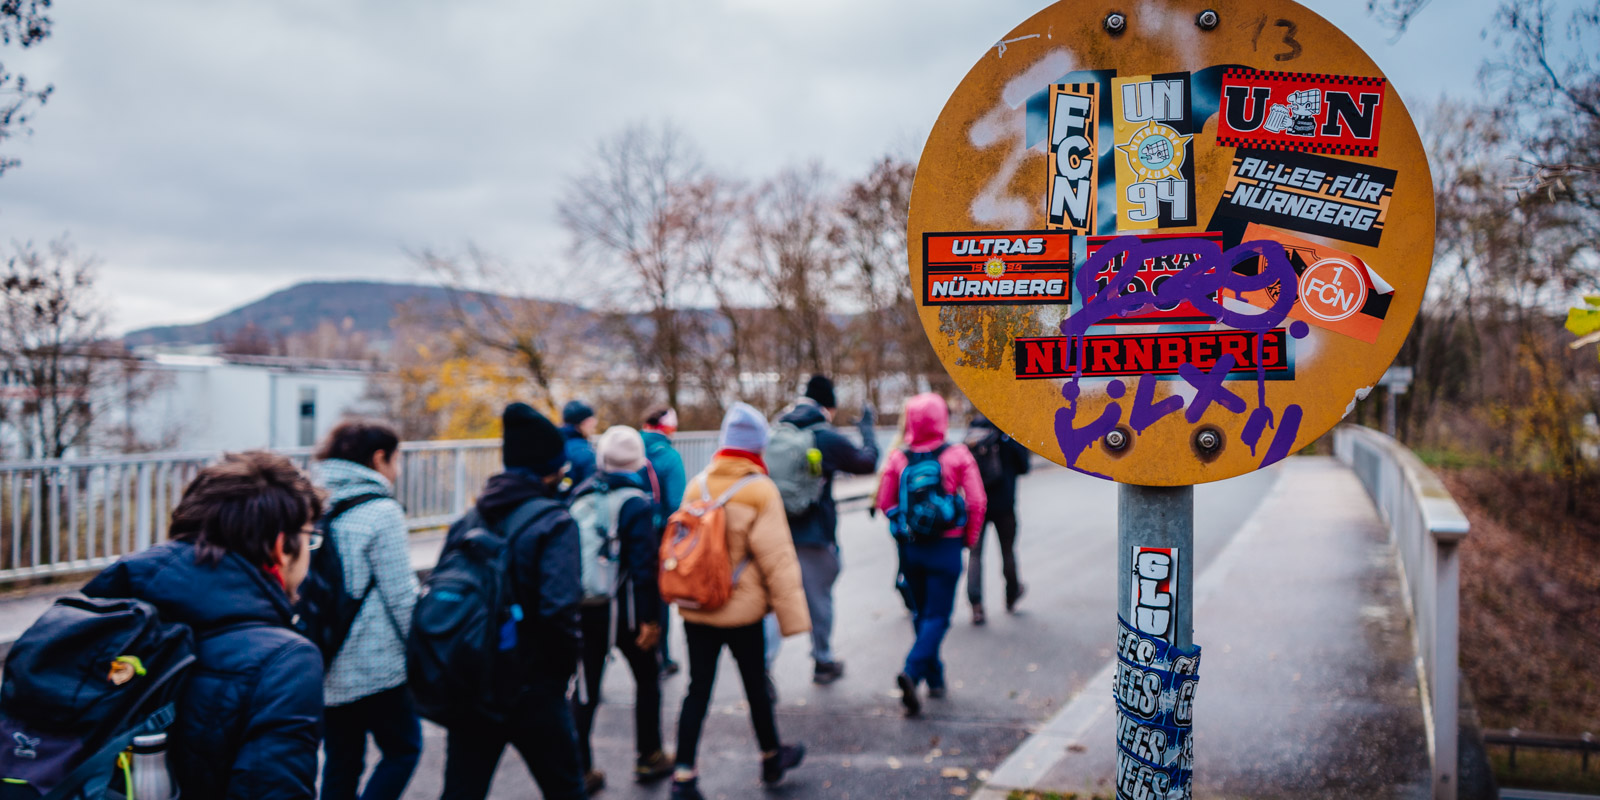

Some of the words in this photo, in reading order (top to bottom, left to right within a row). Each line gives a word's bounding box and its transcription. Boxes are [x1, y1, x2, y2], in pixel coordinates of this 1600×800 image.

[1236, 13, 1302, 61] 13
[1121, 80, 1184, 122] UN
[1130, 126, 1166, 151] ULTRAS
[1238, 157, 1326, 191] ALLES
[1329, 173, 1385, 202] FÜR
[1126, 180, 1188, 221] 94
[1231, 182, 1378, 231] NÜRNBERG
[952, 238, 1046, 255] ULTRAS
[931, 276, 1065, 297] NÜRNBERG
[1305, 278, 1353, 311] FCN
[1136, 551, 1171, 642] GLU
